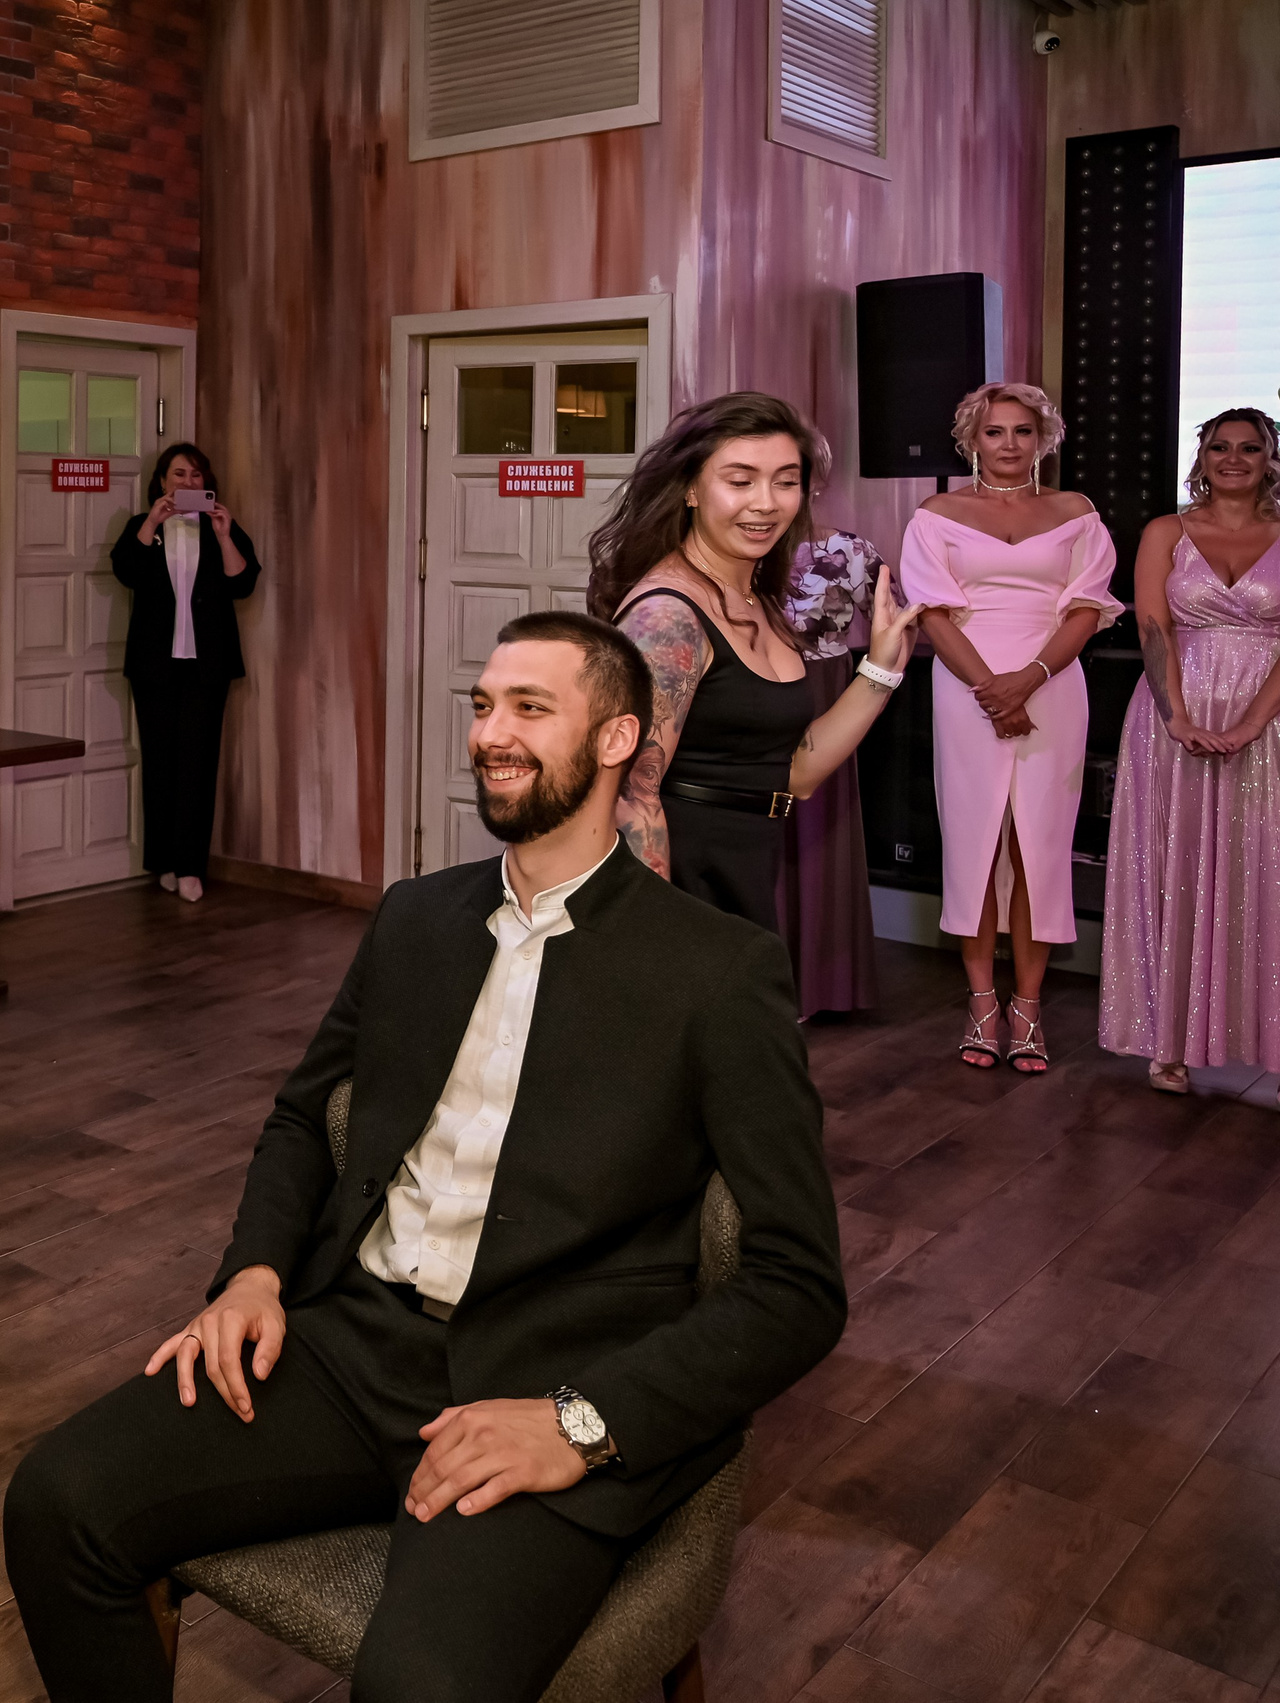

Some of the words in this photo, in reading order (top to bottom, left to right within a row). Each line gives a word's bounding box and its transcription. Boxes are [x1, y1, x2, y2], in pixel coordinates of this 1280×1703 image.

[58, 463, 103, 473] СЛУЖЕБНОЕ
[507, 465, 574, 477] СЛУЖЕБНОЕ
[58, 476, 104, 487] ПОМЕЩЕНИЕ
[506, 480, 575, 492] ПОМЕЩЕНИЕ
